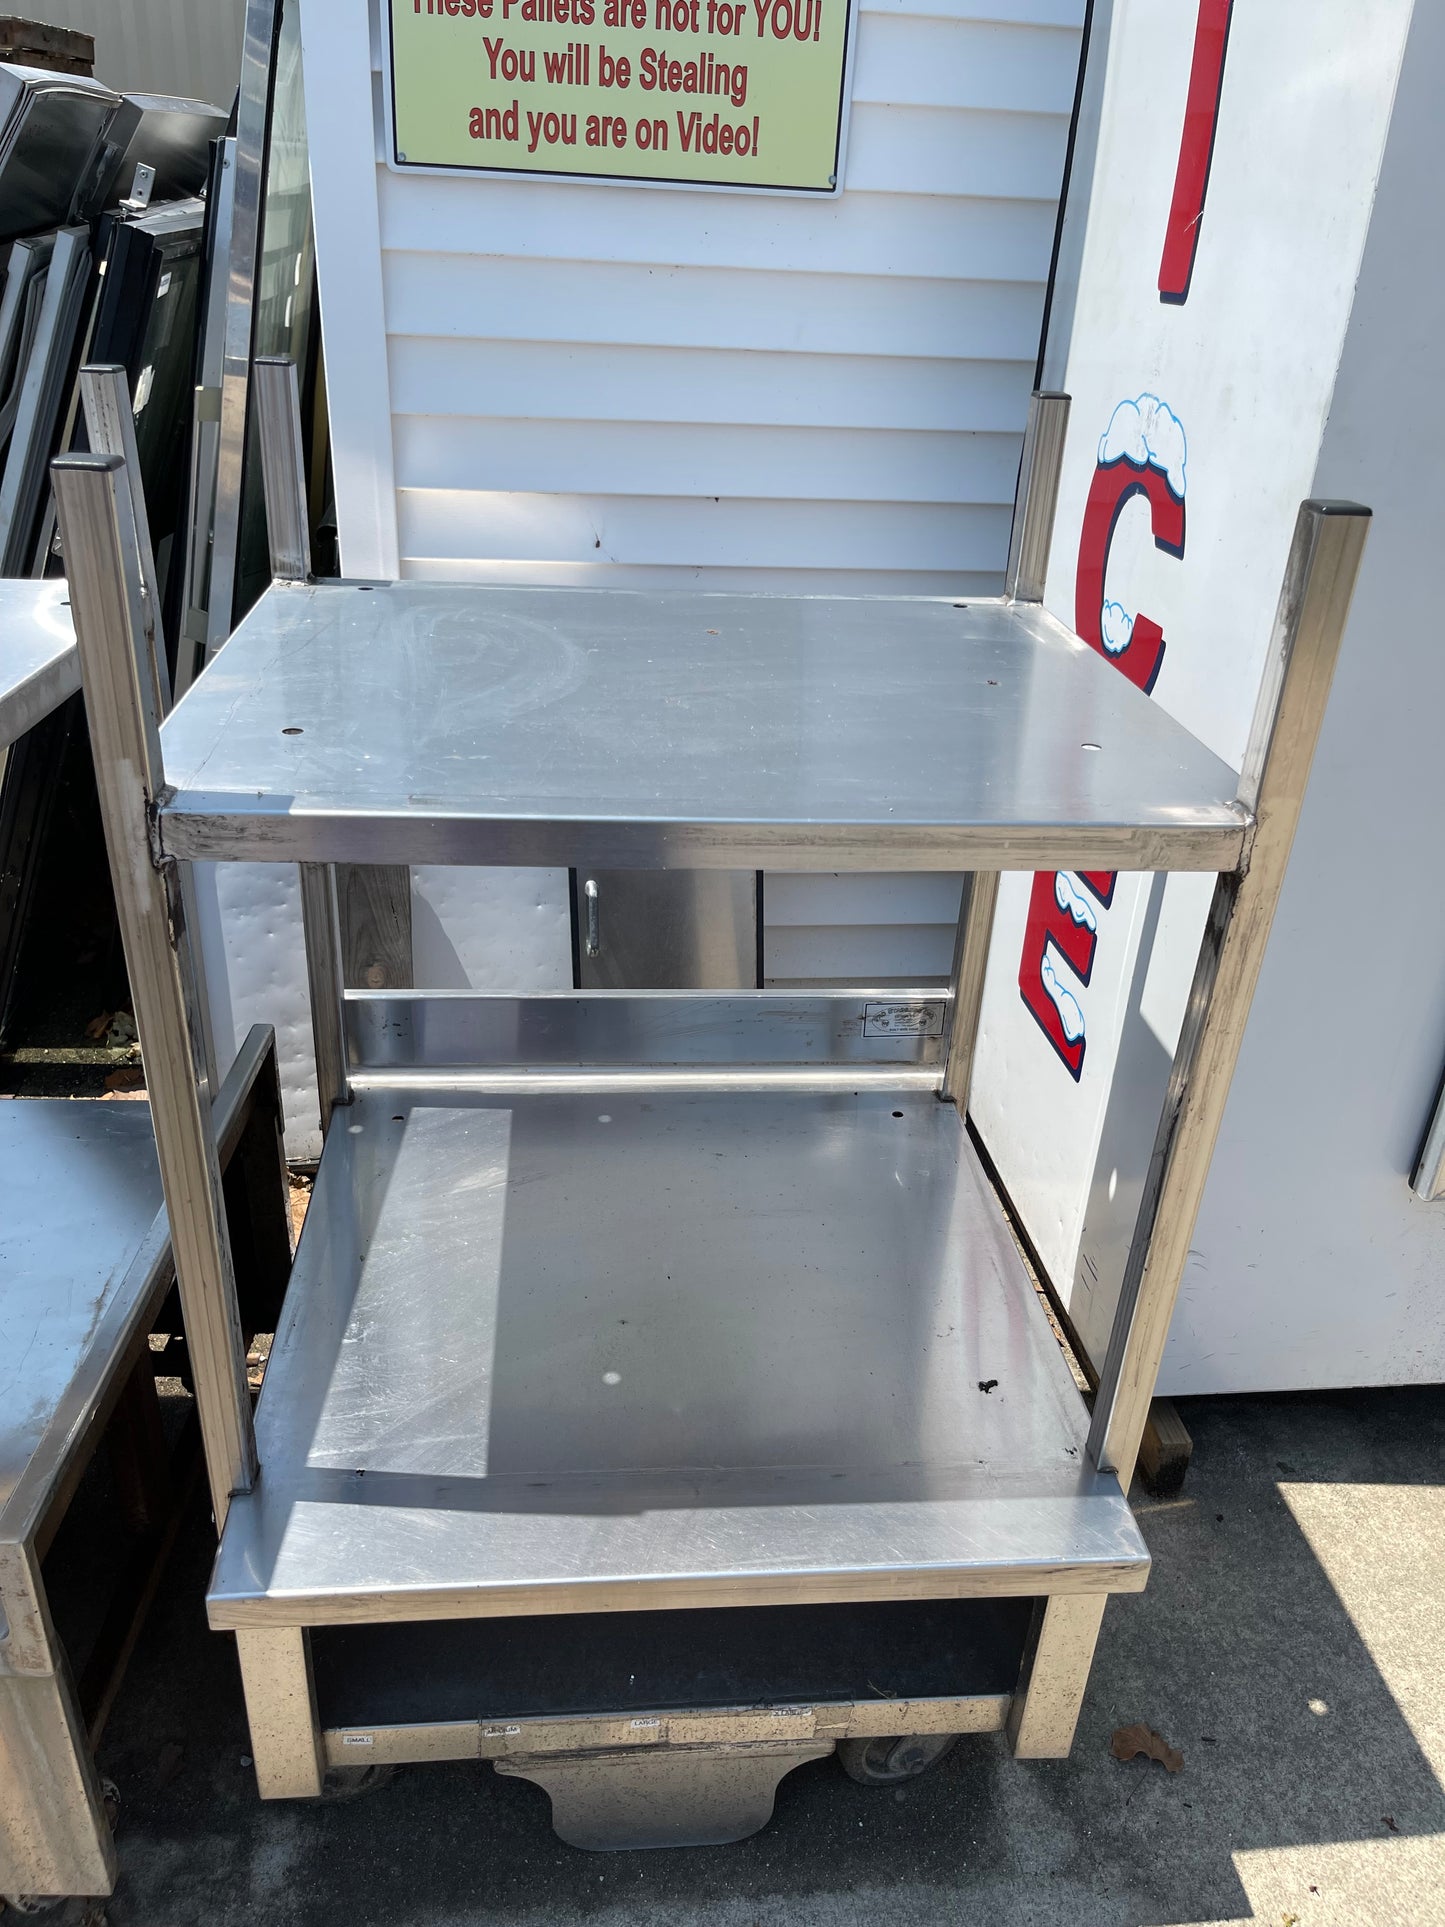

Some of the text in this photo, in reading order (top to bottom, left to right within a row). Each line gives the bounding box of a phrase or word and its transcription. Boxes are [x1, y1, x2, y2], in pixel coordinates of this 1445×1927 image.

[604, 0, 647, 29] are
[655, 0, 700, 33] not
[706, 0, 747, 36] for
[754, 0, 823, 42] YOU!
[482, 37, 749, 107] You will be Stealing
[468, 100, 760, 157] and you are on Video!
